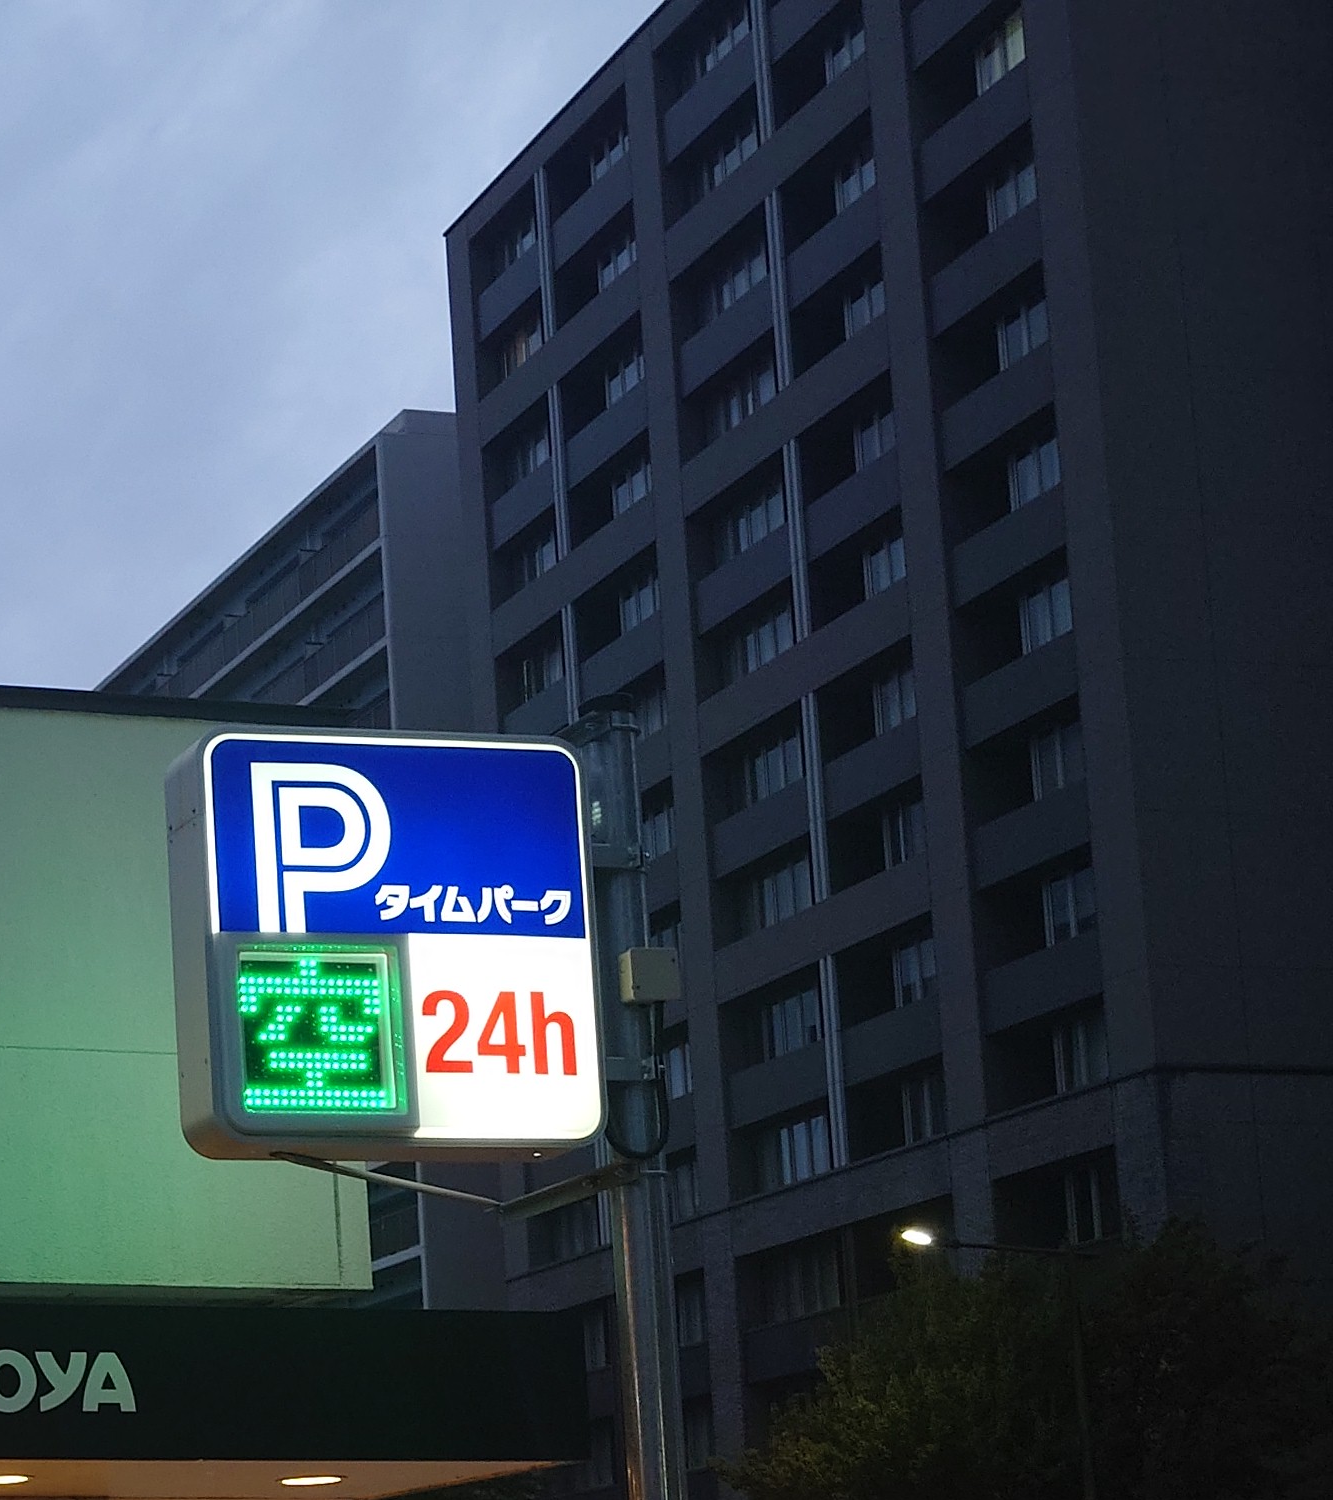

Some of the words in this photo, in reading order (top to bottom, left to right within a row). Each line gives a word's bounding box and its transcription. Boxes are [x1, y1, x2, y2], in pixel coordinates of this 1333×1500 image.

[250, 761, 391, 933] P
[374, 884, 572, 926] タイムパーク
[237, 956, 387, 1108] 空
[421, 989, 578, 1076] 24h
